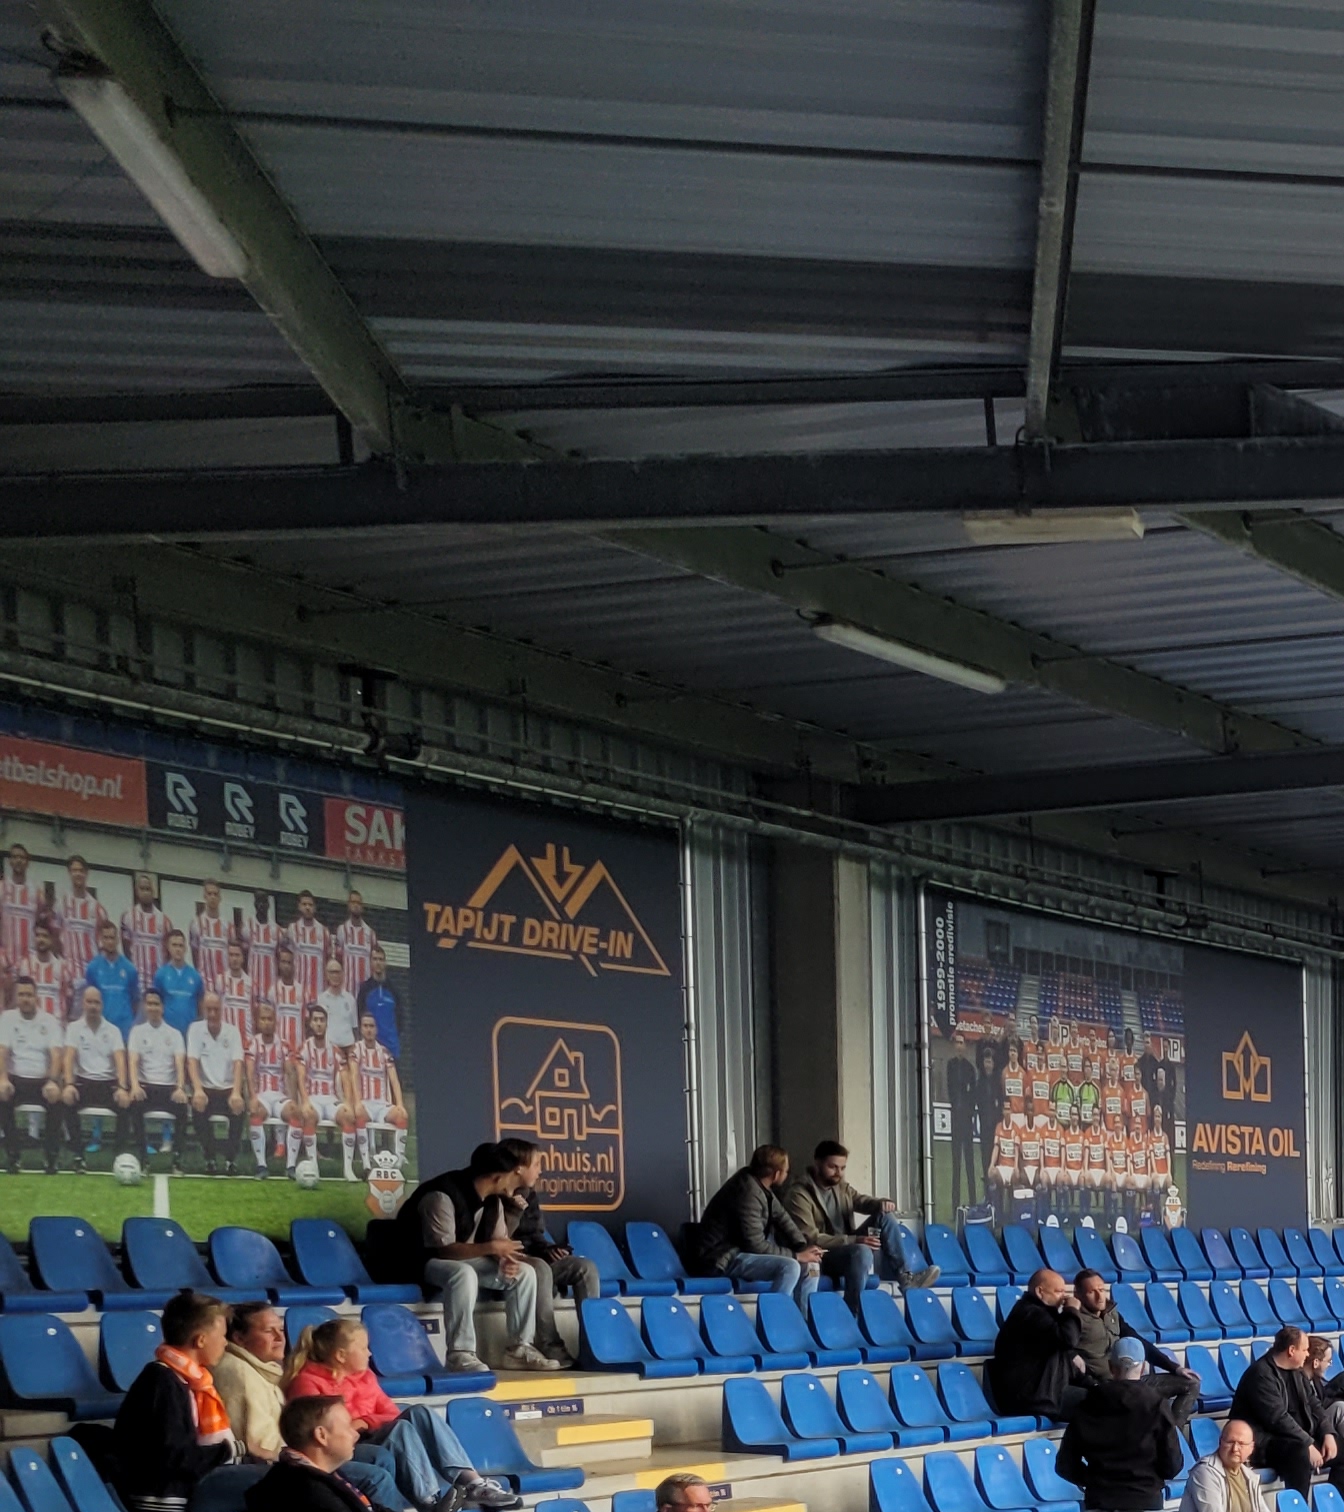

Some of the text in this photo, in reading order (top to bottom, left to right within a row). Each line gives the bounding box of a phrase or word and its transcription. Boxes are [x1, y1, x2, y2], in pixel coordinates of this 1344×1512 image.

[423, 902, 634, 959] TAPIJT DRIVE-IN
[935, 916, 947, 1011] 1999-2000
[1193, 1123, 1301, 1158] AVISTA OIL
[376, 1170, 397, 1180] RBC
[540, 1144, 615, 1174] nhuis.nl
